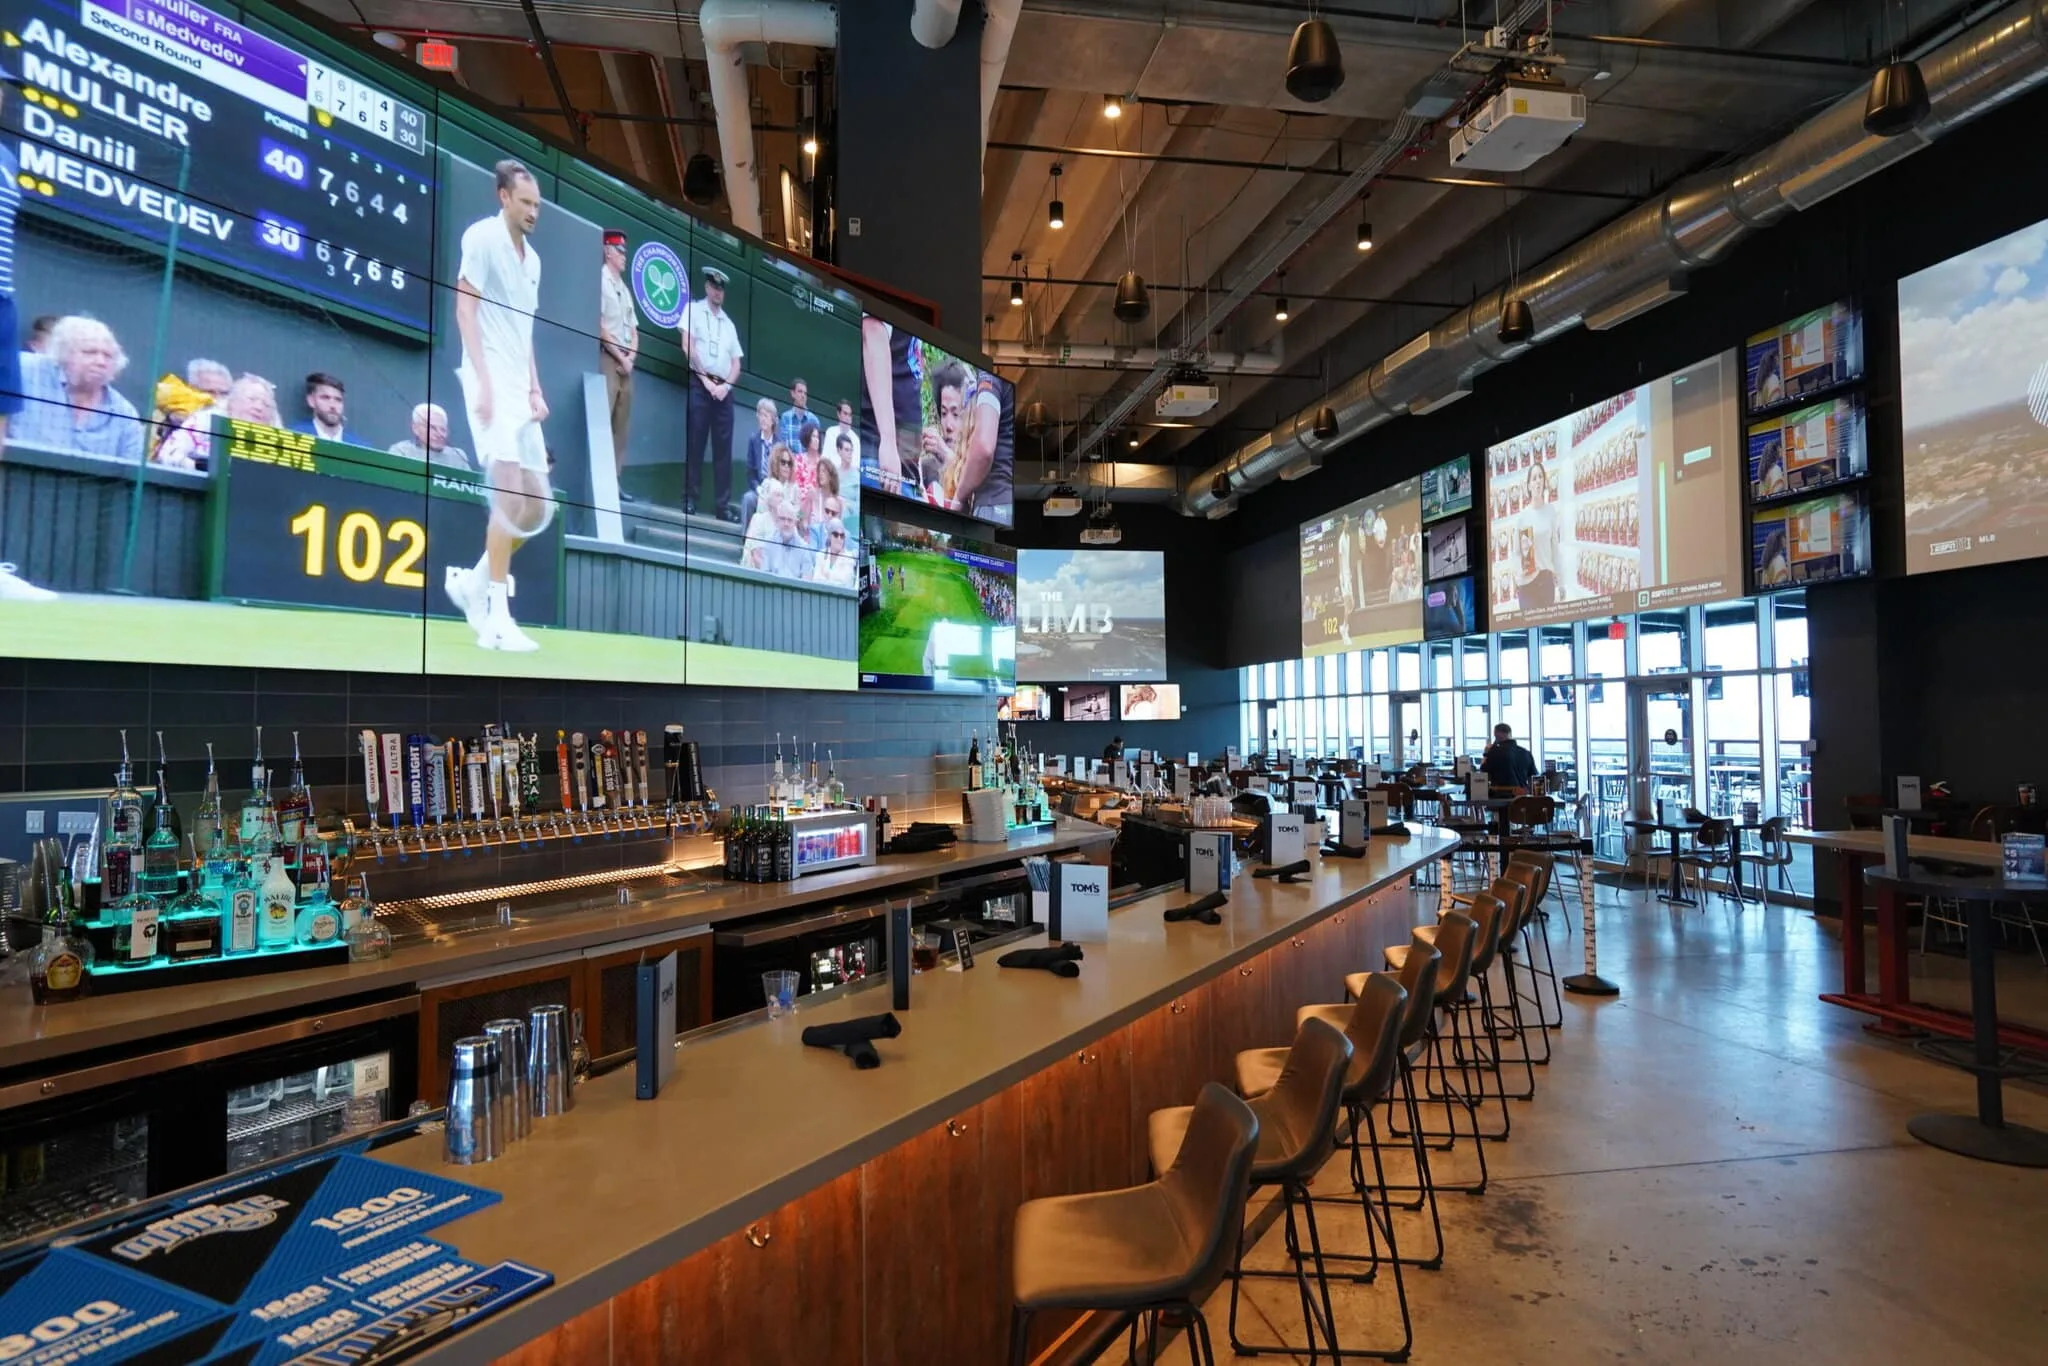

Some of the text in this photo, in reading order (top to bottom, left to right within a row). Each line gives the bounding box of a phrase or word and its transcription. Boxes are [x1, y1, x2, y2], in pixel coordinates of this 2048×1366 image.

[22, 17, 212, 122] Alexandre
[90, 10, 203, 70] Second Round
[23, 51, 191, 147] MULLER
[146, 9, 245, 67] Medvedev
[336, 99, 346, 112] 7
[358, 110, 368, 123] 6
[379, 119, 389, 133] 5
[400, 128, 417, 146] 30
[213, 21, 243, 45] FRA
[315, 68, 325, 81] 7
[380, 100, 389, 113] 4
[400, 109, 418, 127] 40
[23, 104, 136, 171] Daniil
[19, 140, 234, 241] MEDVEDEV
[264, 147, 304, 181] 40
[317, 166, 335, 191] 7
[329, 193, 340, 207] 7
[345, 181, 360, 203] 6
[370, 193, 386, 214] 4
[392, 202, 408, 225] 4
[262, 218, 406, 290] 30 6 3 7 7 6 5
[229, 419, 316, 473] IBM
[291, 503, 425, 588] 102
[1021, 603, 1114, 633] LIMB
[1041, 592, 1063, 601] THE
[1323, 617, 1338, 635] 102
[390, 737, 398, 769] ULTRA
[410, 746, 422, 805] BUD LIGHT
[529, 762, 540, 795] IPA
[1194, 847, 1214, 857] TOM'S
[1277, 825, 1299, 833] TOM'S
[1071, 882, 1100, 893] TOM'S
[311, 1187, 423, 1230] 1800
